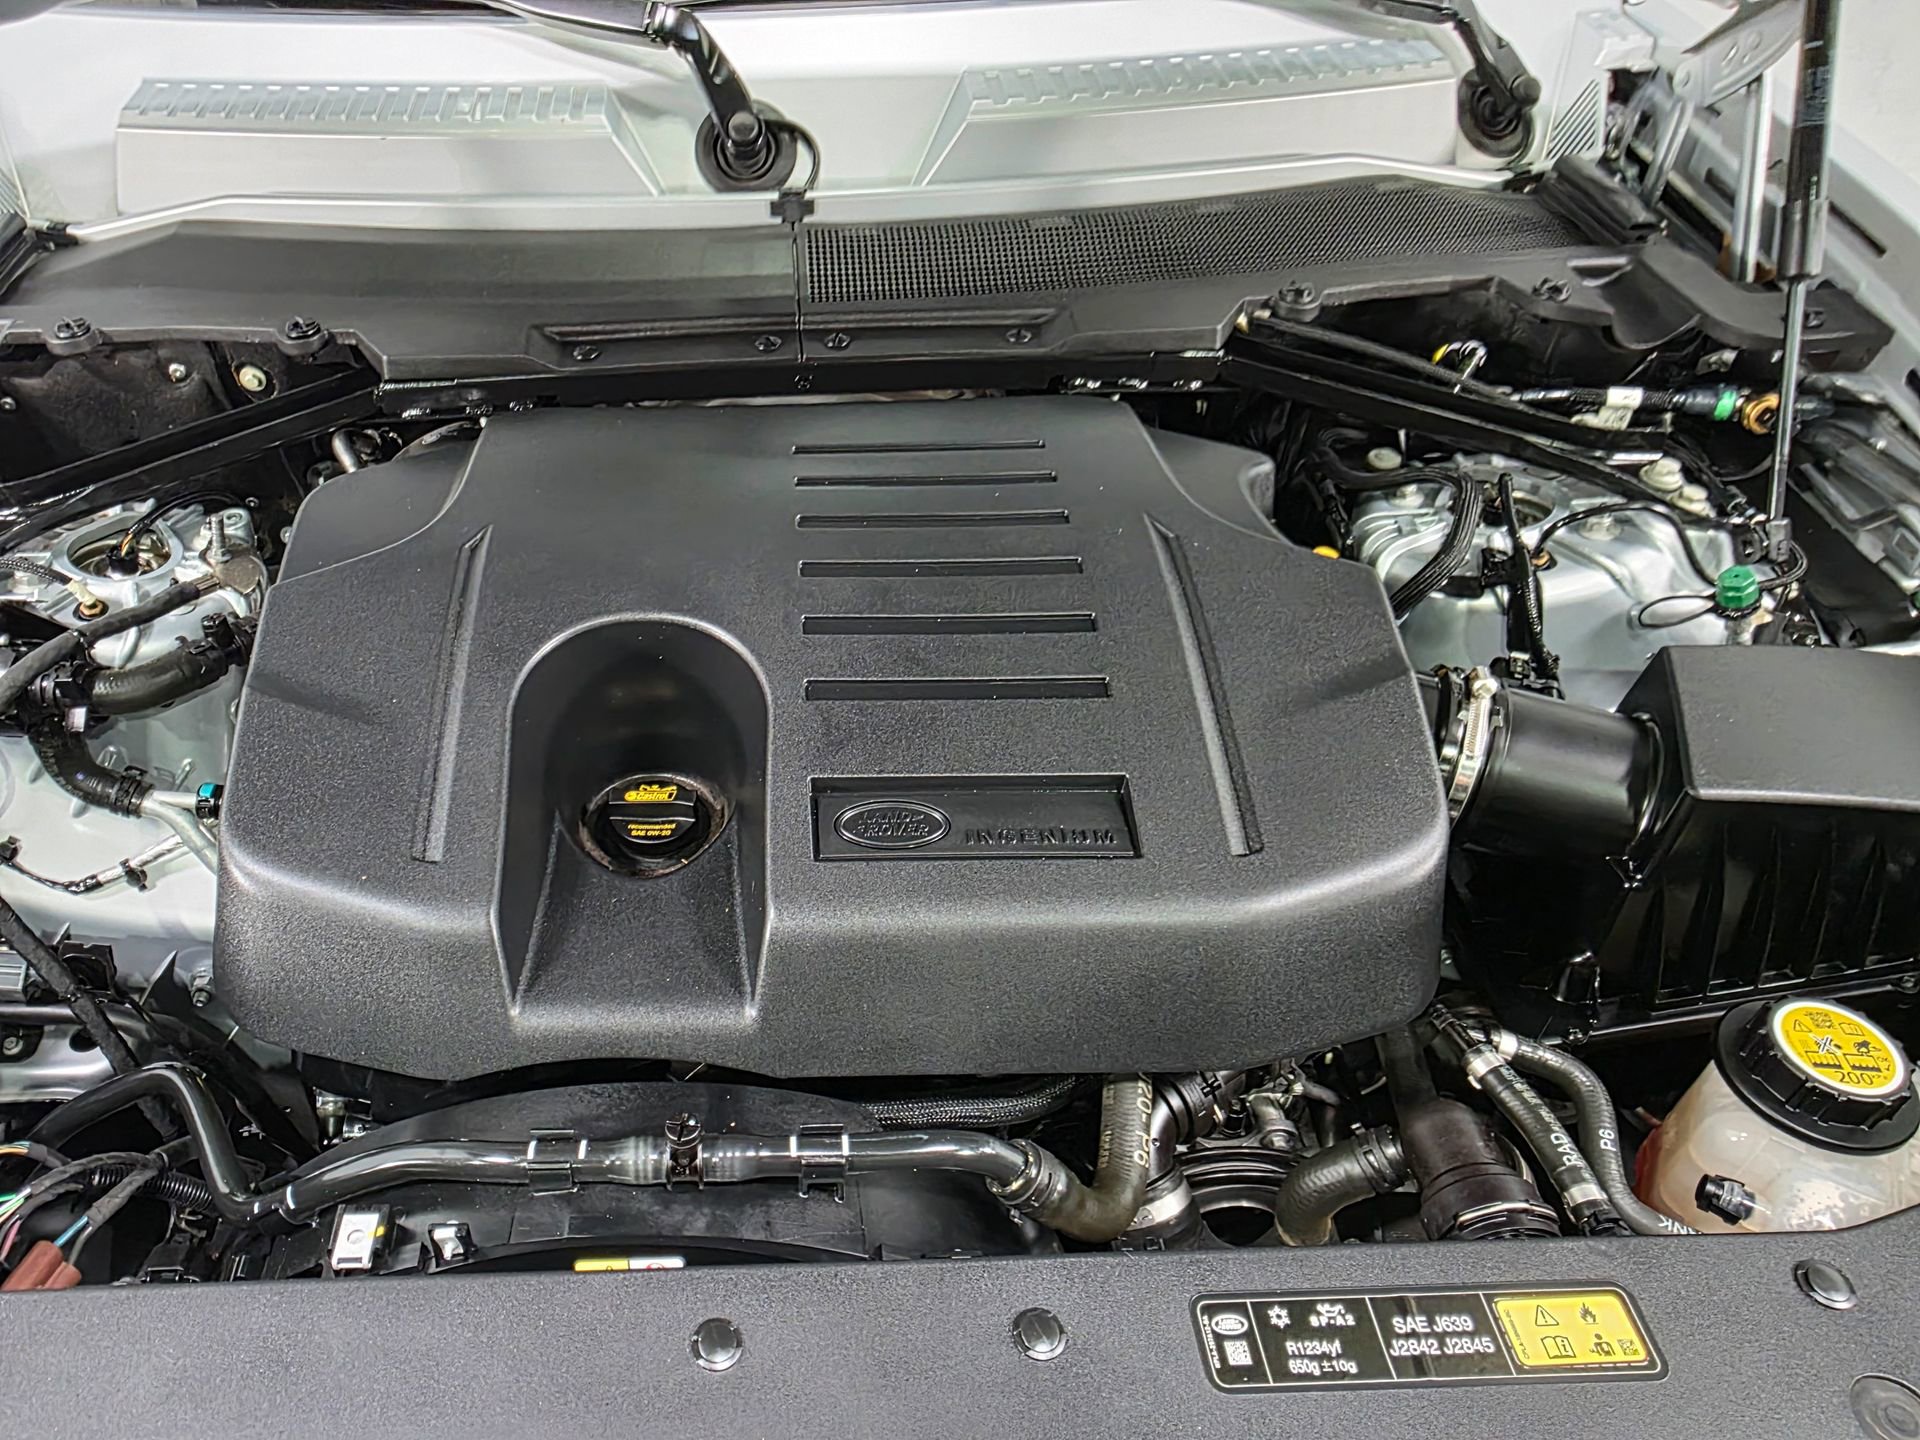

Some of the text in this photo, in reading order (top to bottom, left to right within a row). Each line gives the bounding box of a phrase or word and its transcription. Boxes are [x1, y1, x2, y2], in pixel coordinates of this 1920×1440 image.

[627, 822, 677, 830] recommended
[631, 829, 672, 837] SAE 0W-20
[964, 826, 1118, 845] INGENIUM
[1598, 1127, 1617, 1152] P6
[1550, 1132, 1583, 1168] RAD
[1391, 1314, 1475, 1334] SAE J639
[1285, 1339, 1343, 1358] R1234yf
[1389, 1336, 1496, 1357] J2842 J2845
[1288, 1358, 1360, 1377] 650g ±10g
